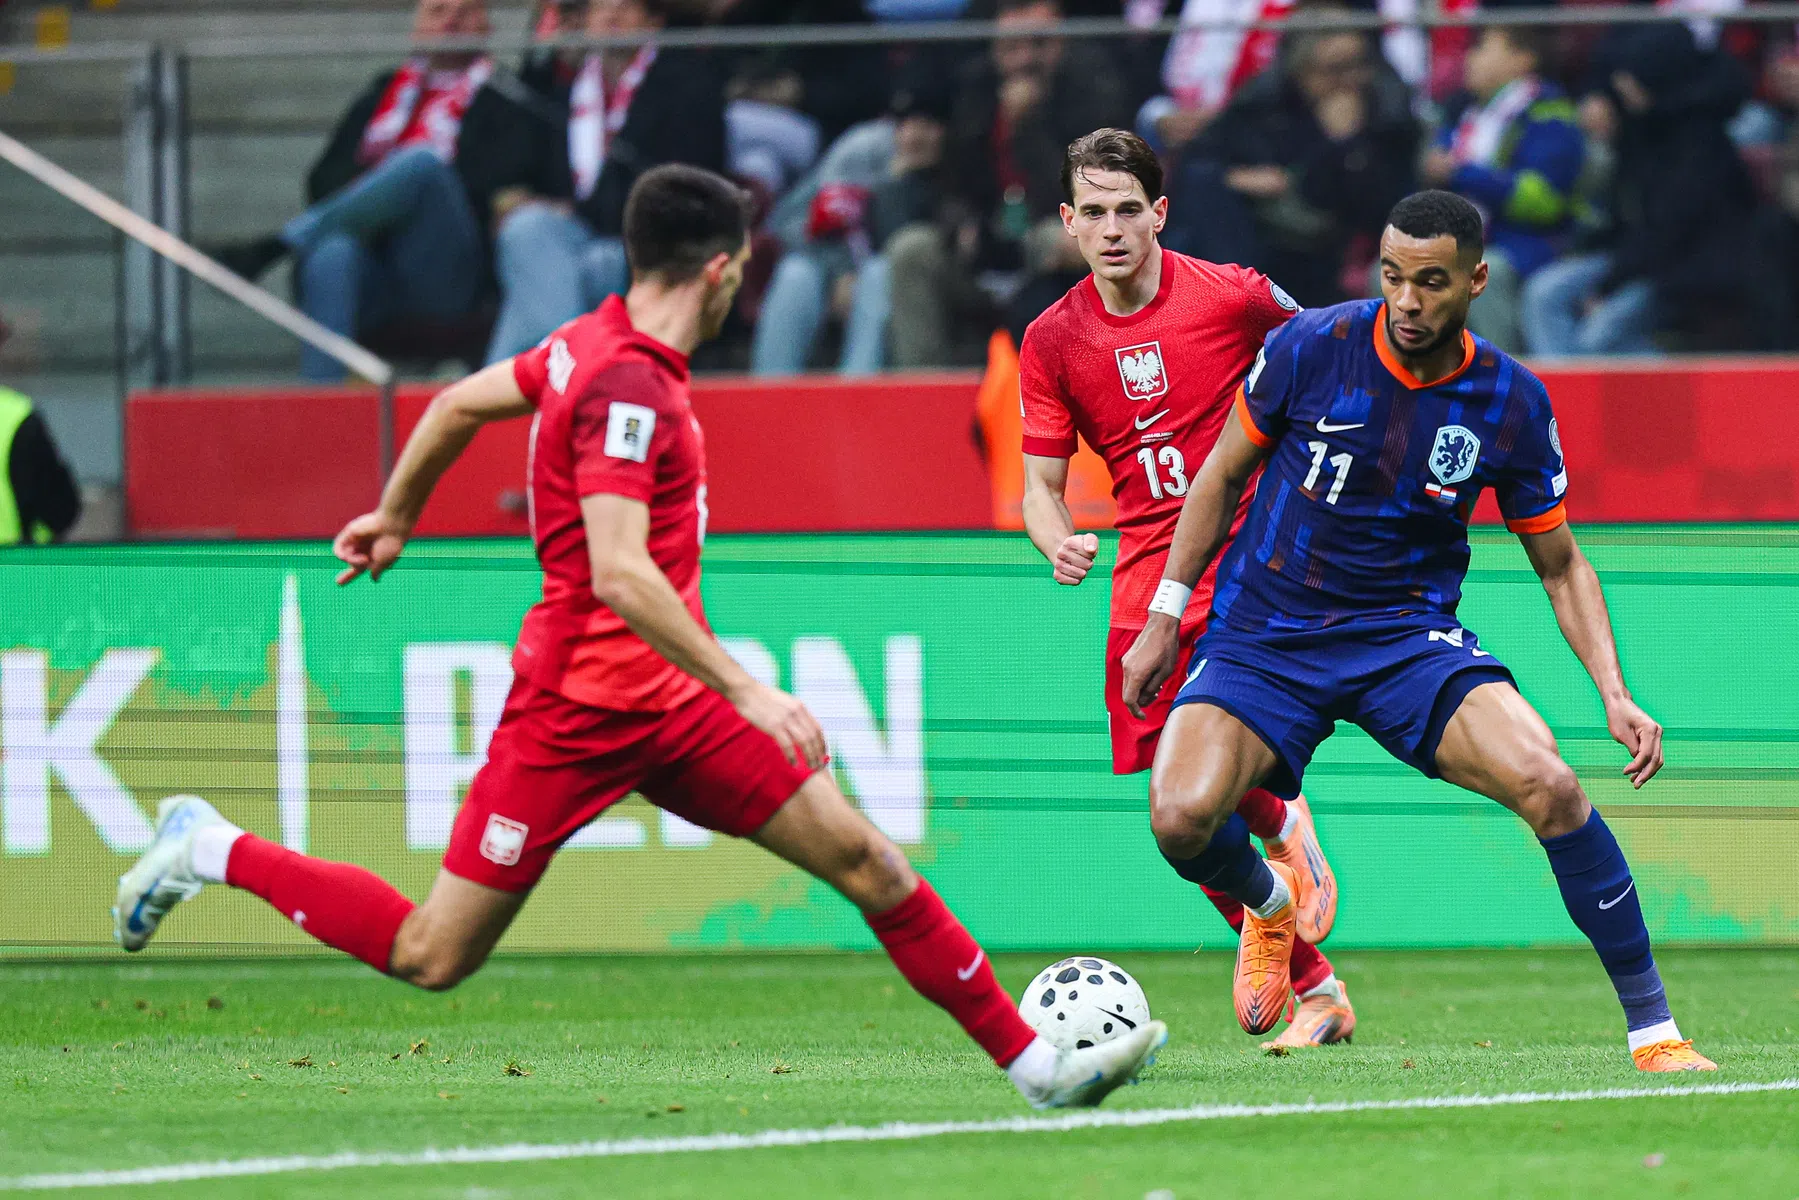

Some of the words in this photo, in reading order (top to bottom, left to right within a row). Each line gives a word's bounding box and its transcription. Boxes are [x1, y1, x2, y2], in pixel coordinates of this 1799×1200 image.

[1136, 446, 1190, 499] 13
[1303, 441, 1354, 506] 11
[1, 647, 161, 855] K
